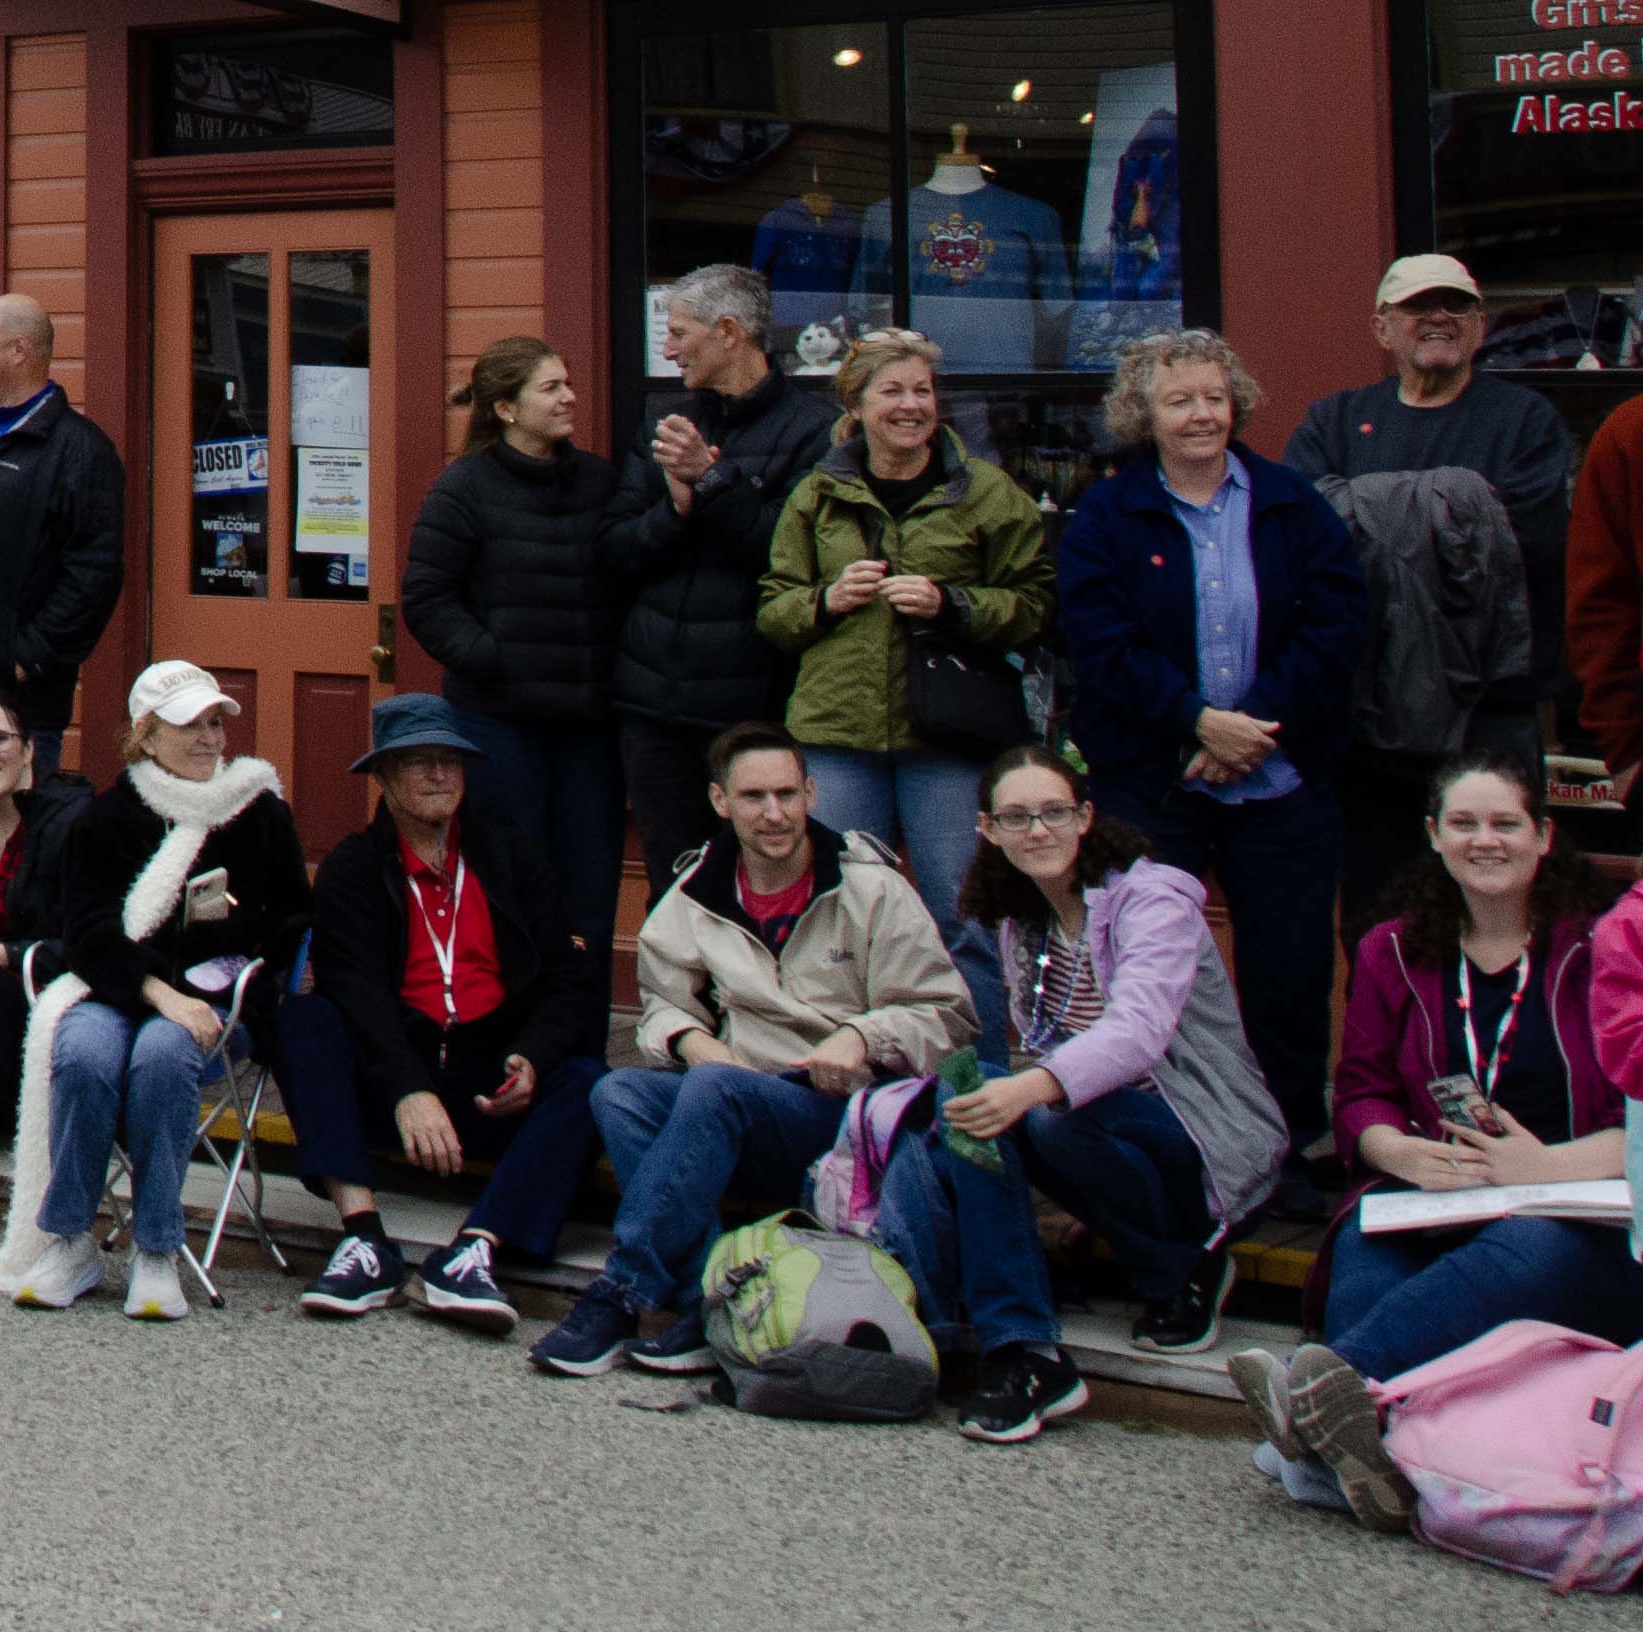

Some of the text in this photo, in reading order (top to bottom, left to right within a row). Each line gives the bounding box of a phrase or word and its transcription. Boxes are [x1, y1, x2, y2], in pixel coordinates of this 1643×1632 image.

[1494, 40, 1632, 84] made
[194, 445, 243, 474] CLOSED
[201, 519, 261, 534] WELCOME
[200, 567, 258, 579] SHOP LOCAL
